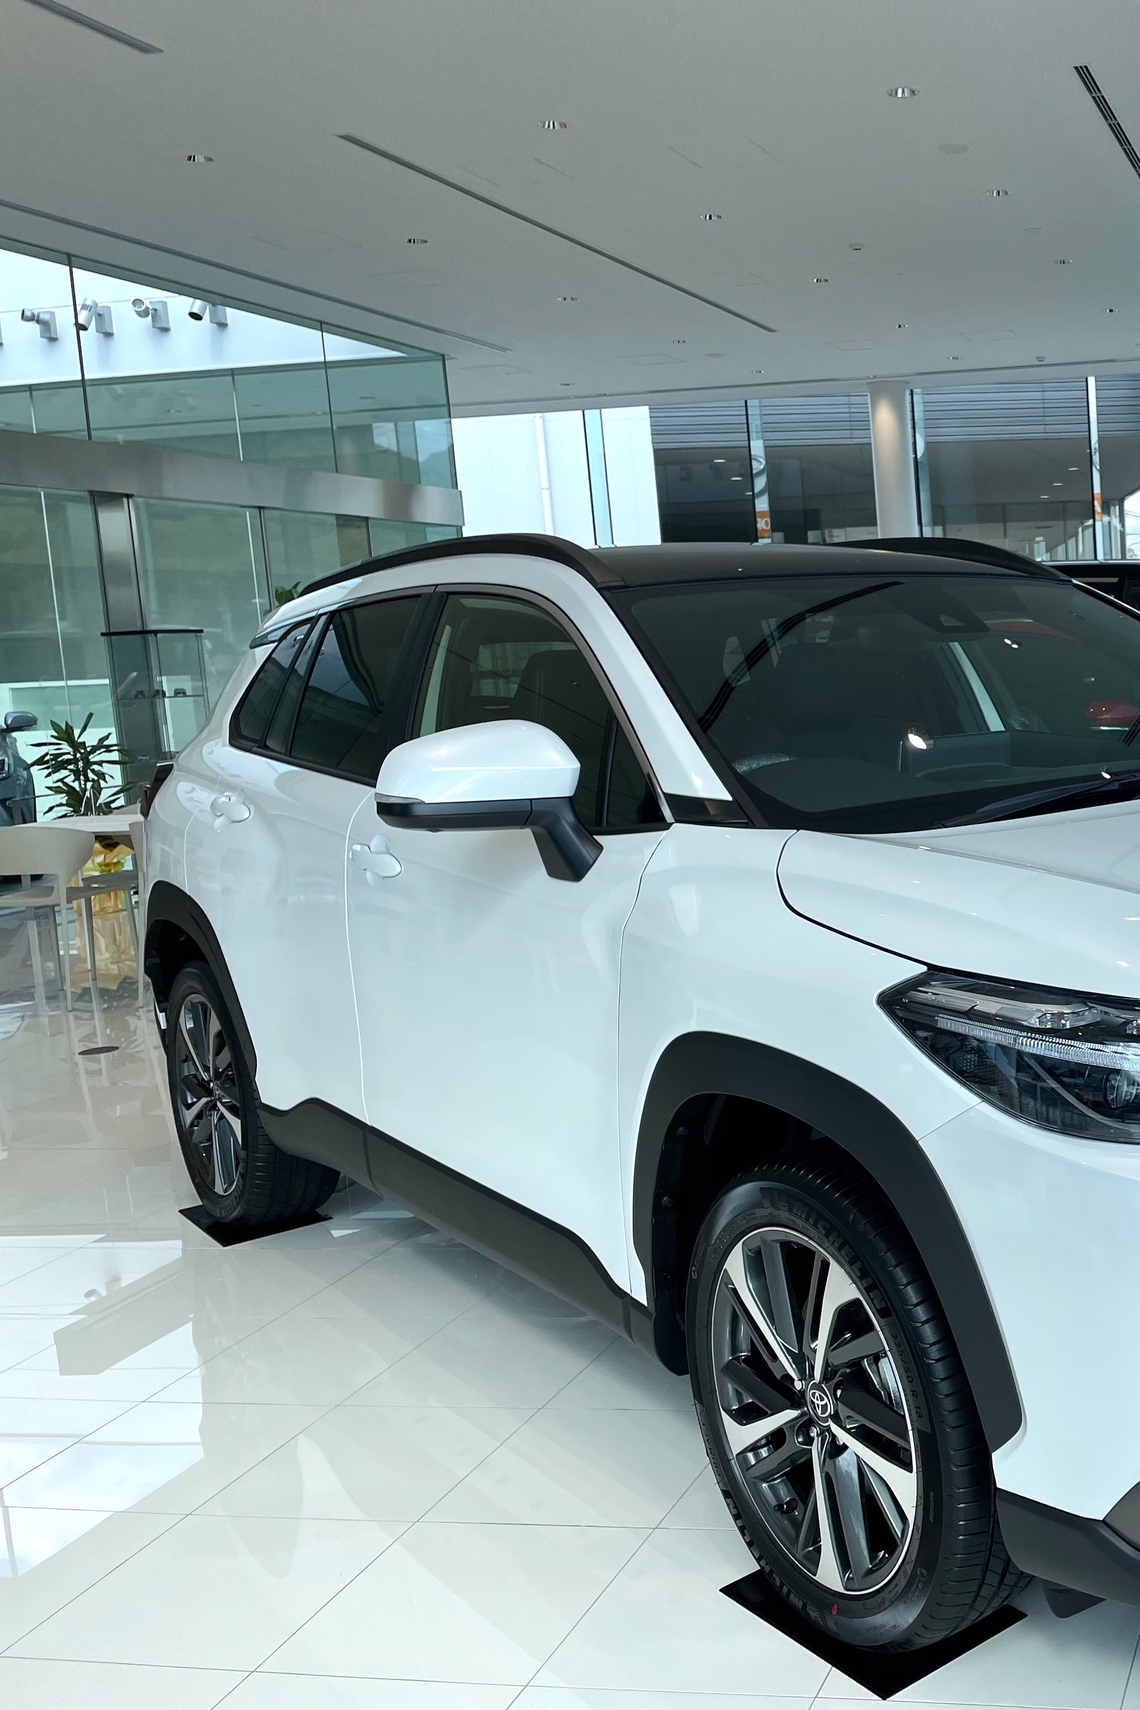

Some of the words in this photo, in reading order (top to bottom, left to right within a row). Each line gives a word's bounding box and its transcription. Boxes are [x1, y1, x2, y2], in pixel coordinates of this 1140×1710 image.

[792, 1202, 887, 1309] MICHELIN
[891, 1333, 914, 1383] 225/50
[914, 1405, 924, 1419] 18
[726, 1498, 804, 1610] MICHELIN
